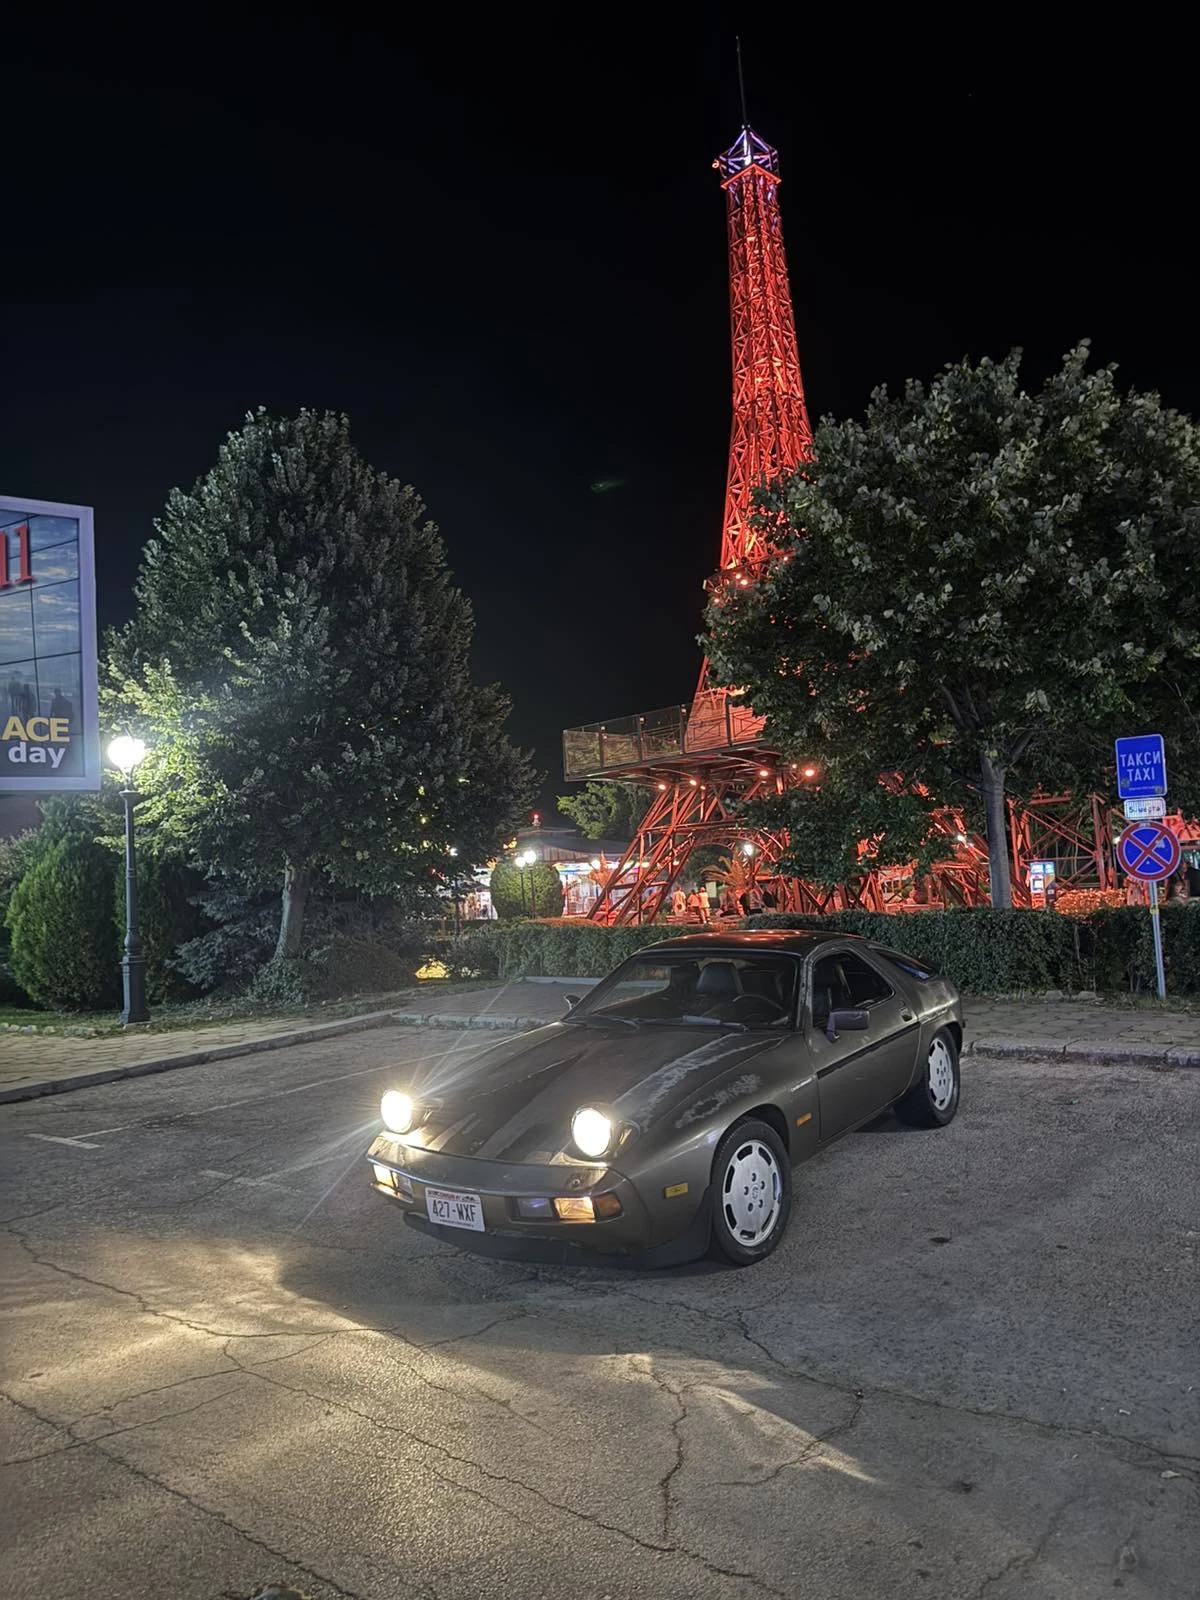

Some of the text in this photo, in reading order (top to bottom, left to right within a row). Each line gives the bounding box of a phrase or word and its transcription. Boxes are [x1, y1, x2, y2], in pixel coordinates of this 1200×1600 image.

[8, 741, 66, 769] day
[1120, 750, 1161, 768] ТАКСИ
[1127, 767, 1156, 782] TAXI
